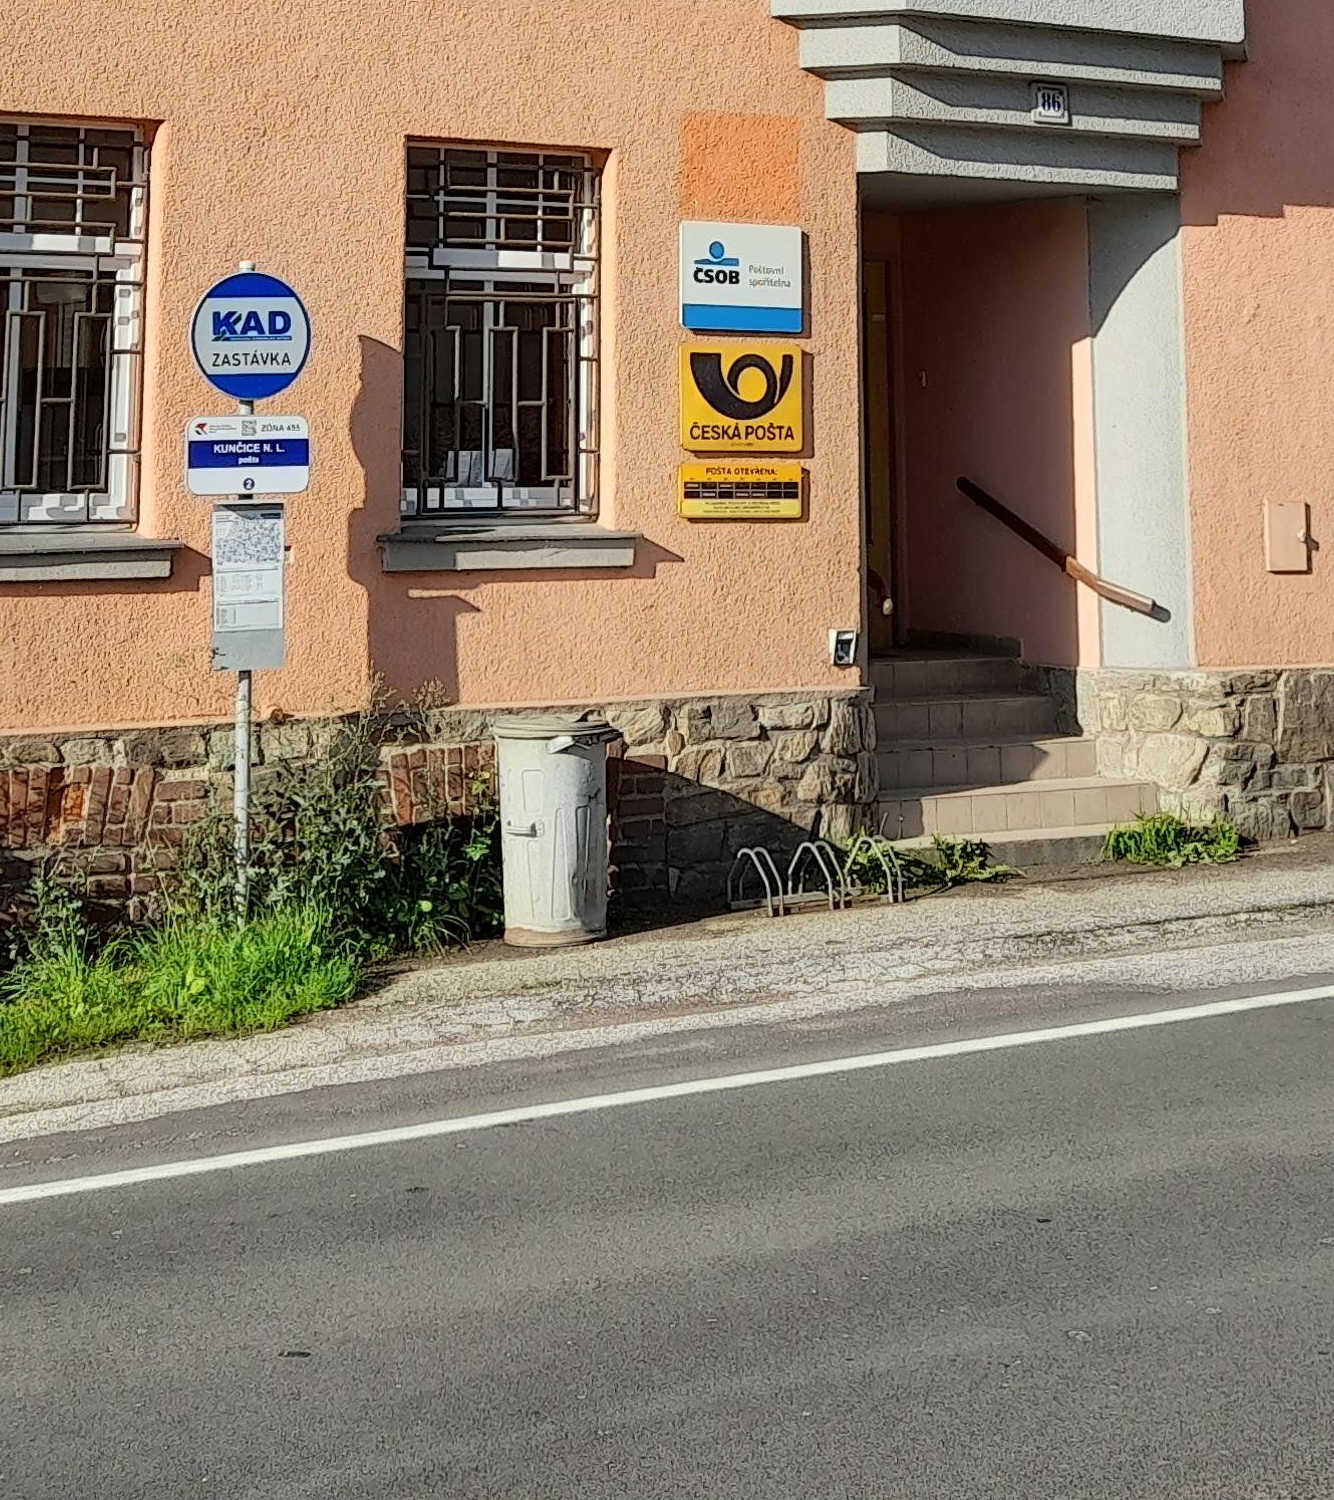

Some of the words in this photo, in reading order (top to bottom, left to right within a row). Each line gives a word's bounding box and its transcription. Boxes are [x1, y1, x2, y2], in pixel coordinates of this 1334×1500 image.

[1042, 92, 1061, 112] 86
[693, 267, 740, 284] ČSOB
[211, 311, 292, 335] KAD
[212, 350, 292, 367] ZASTÁVKA
[690, 422, 742, 440] ČESKÁ
[745, 422, 795, 441] POŠTA
[213, 442, 261, 454] KUNČICE
[263, 444, 273, 453] N.
[276, 444, 285, 453] L.
[238, 455, 260, 465] pošta
[706, 466, 732, 475] POŠTA
